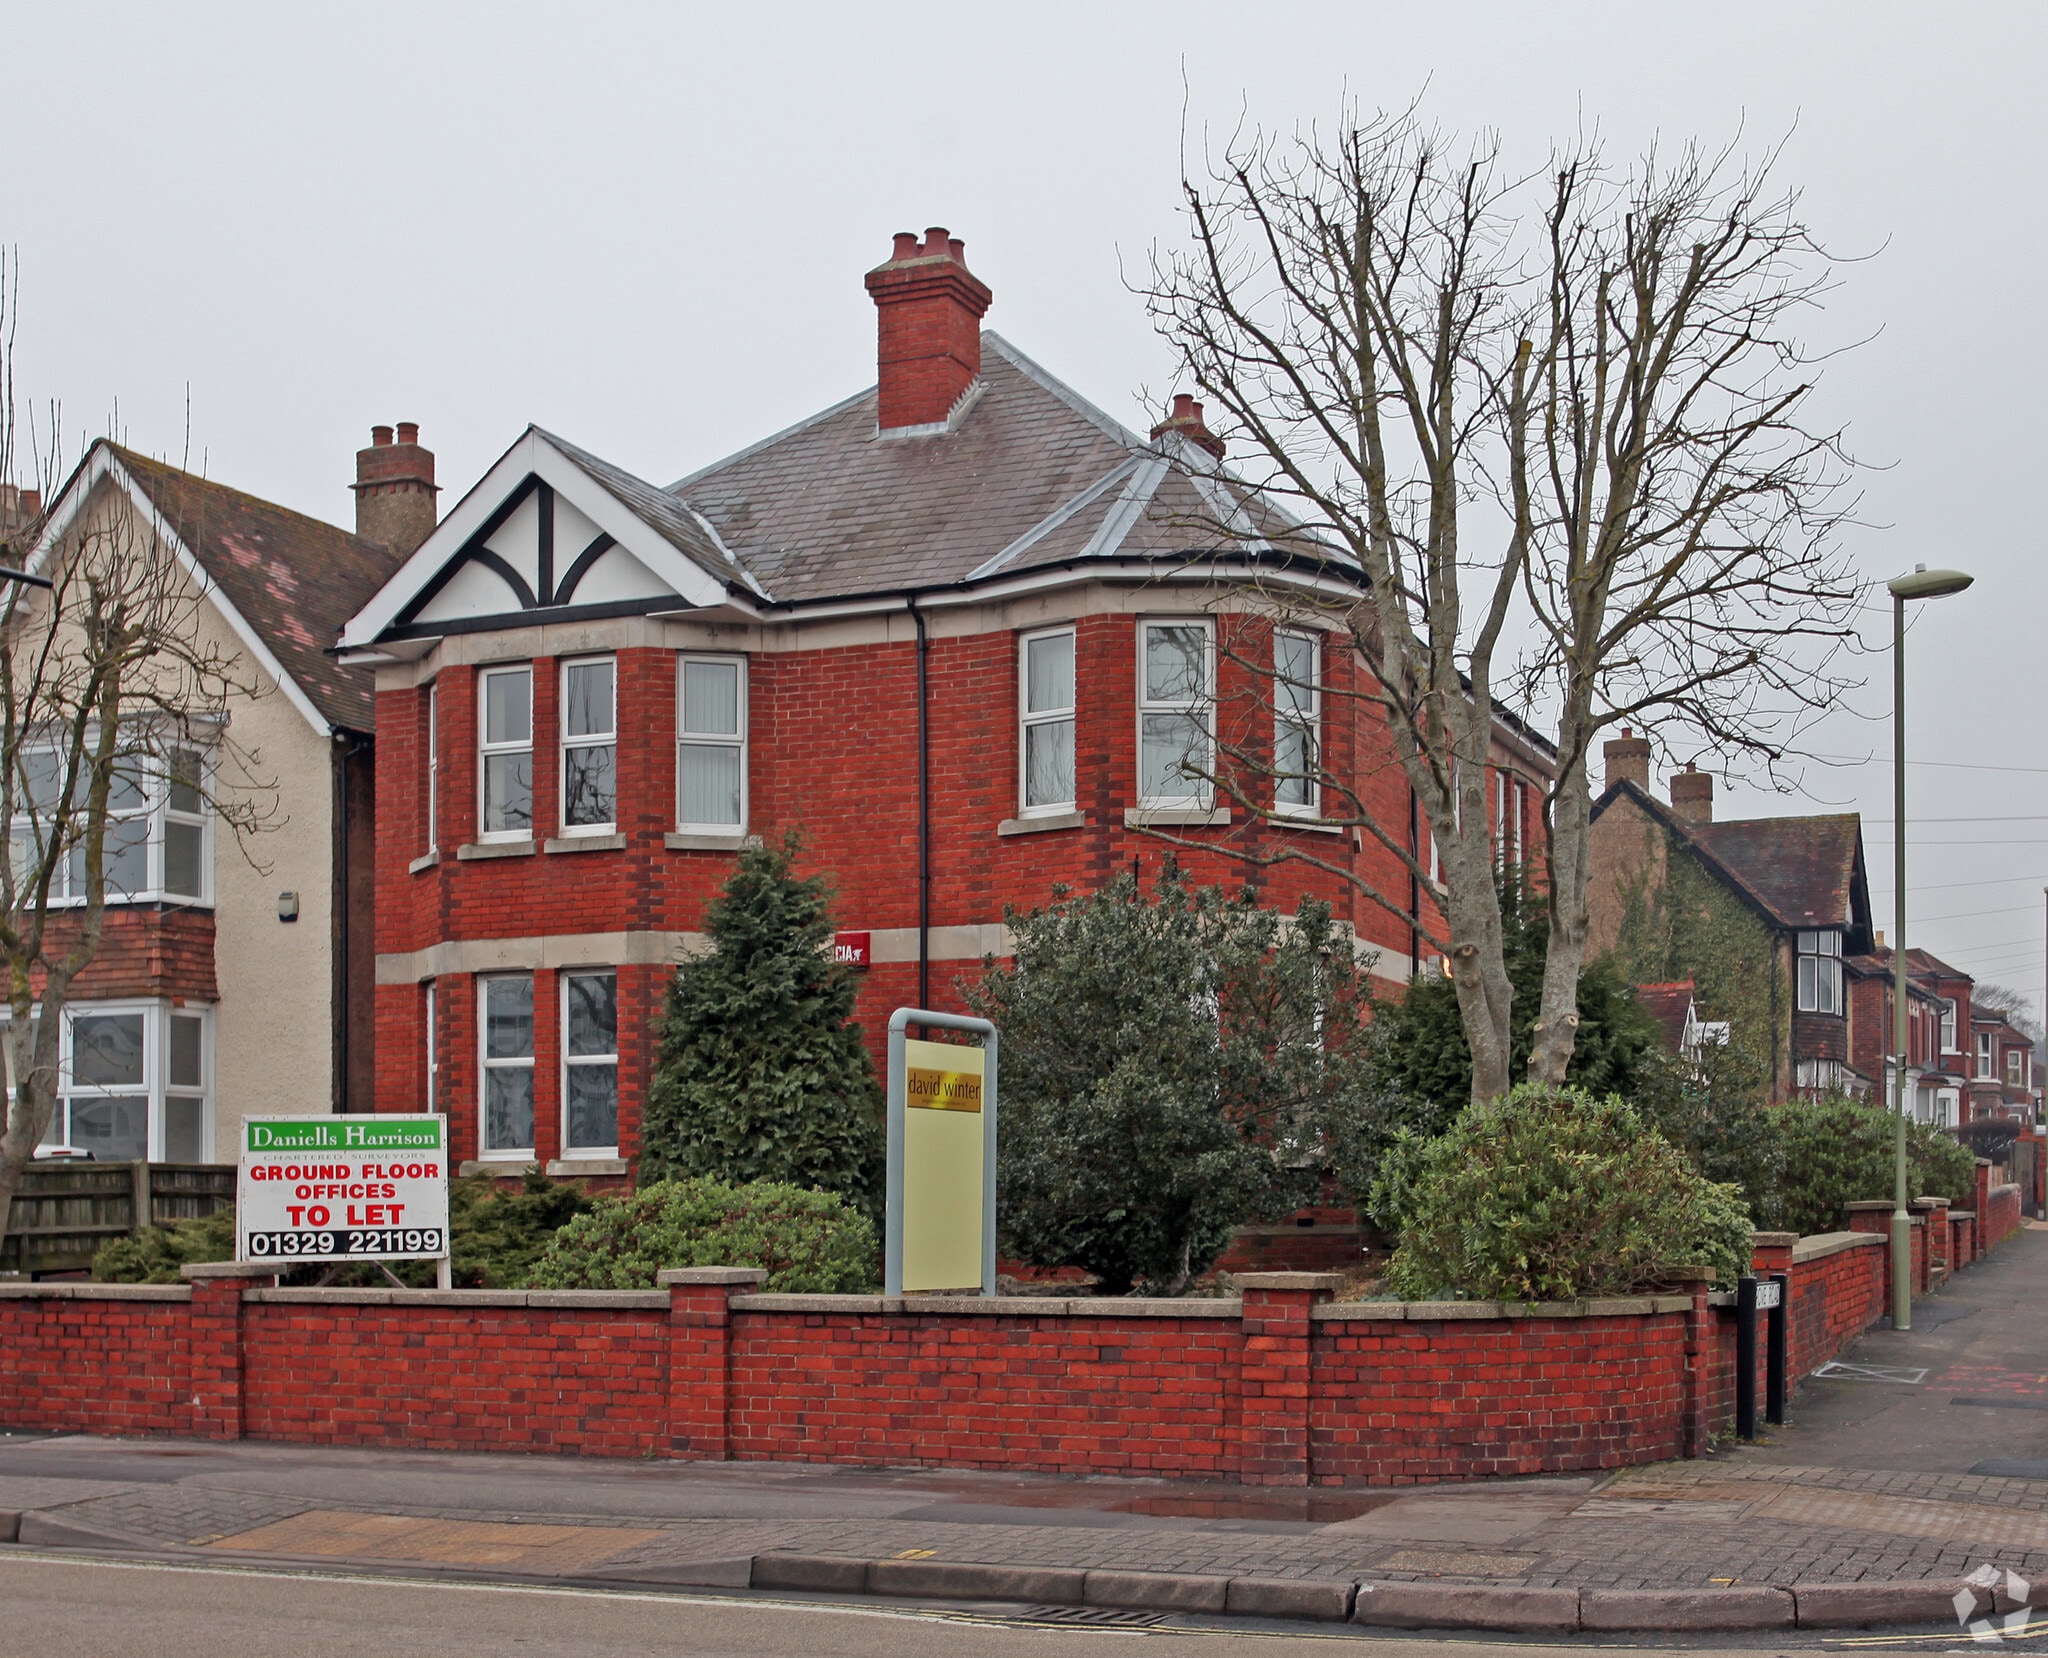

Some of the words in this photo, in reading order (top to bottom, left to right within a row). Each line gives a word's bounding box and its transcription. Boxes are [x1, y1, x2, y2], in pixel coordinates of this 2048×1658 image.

[908, 1072, 941, 1097] david
[944, 1078, 980, 1100] winter
[252, 1126, 338, 1147] Daniells
[345, 1125, 436, 1146] Harrison
[263, 1153, 343, 1161] CHARTERED
[351, 1152, 426, 1160] SURVEYORS
[250, 1164, 351, 1181] GROUND
[362, 1163, 439, 1180] FLOOR
[295, 1183, 396, 1200] OFFICES
[286, 1205, 331, 1227] TO
[347, 1203, 405, 1226] LET
[251, 1231, 335, 1255] 01329
[348, 1229, 441, 1253] 221199
[1756, 1285, 1767, 1307] OVE
